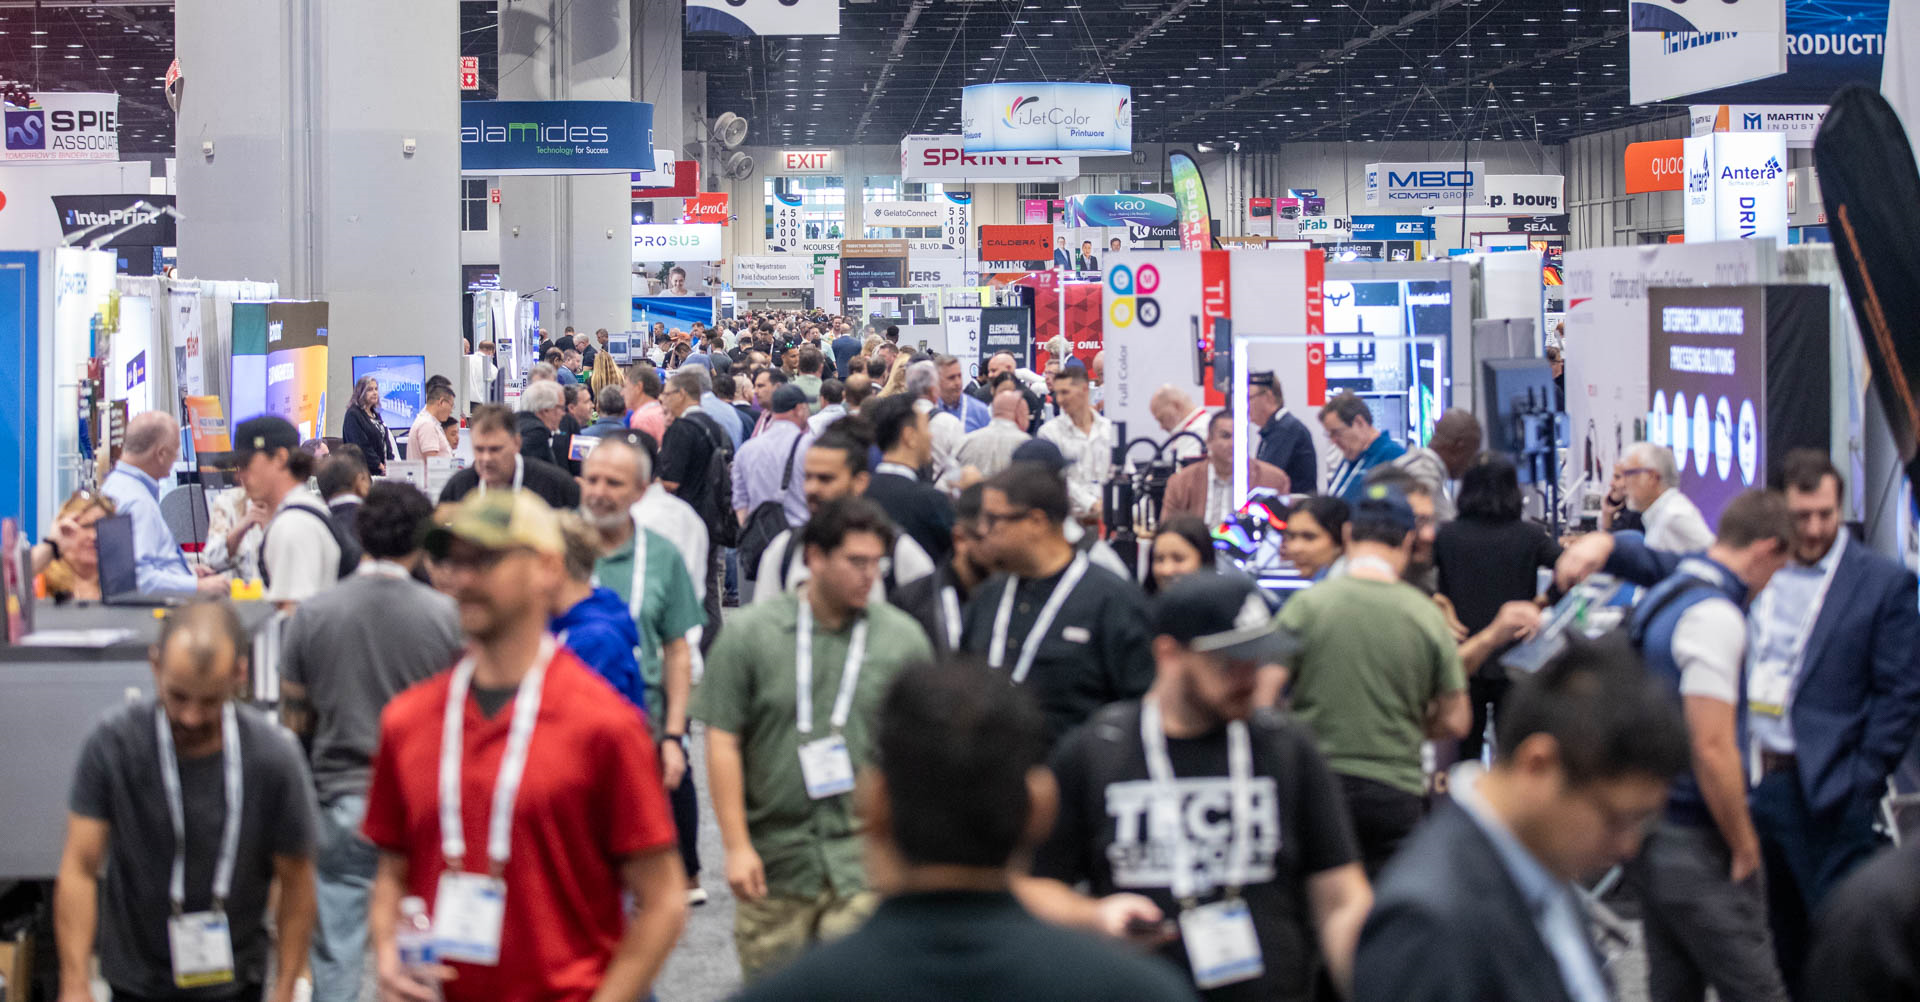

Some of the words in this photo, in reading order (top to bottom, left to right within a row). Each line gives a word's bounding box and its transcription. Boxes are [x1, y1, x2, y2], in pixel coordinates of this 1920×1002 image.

[1019, 108, 1090, 126] iJetColor
[1070, 128, 1104, 137] Printware
[536, 146, 573, 156] Technology
[575, 146, 584, 154] for
[586, 146, 609, 154] Success
[786, 154, 827, 169] EXIT
[1389, 171, 1474, 187] MBO
[1721, 166, 1776, 179] Antera
[1513, 193, 1557, 209] bourg
[74, 210, 157, 225] IntoPrint
[1152, 228, 1176, 236] Kornit
[634, 235, 700, 247] PROSUB
[756, 263, 786, 271] Registration
[909, 271, 941, 281] TERS
[989, 324, 1019, 334] ELECTRICAL
[1118, 345, 1128, 377] Color
[391, 380, 420, 394] cooling
[1120, 380, 1128, 406] Full
[1105, 777, 1280, 844] TCH
